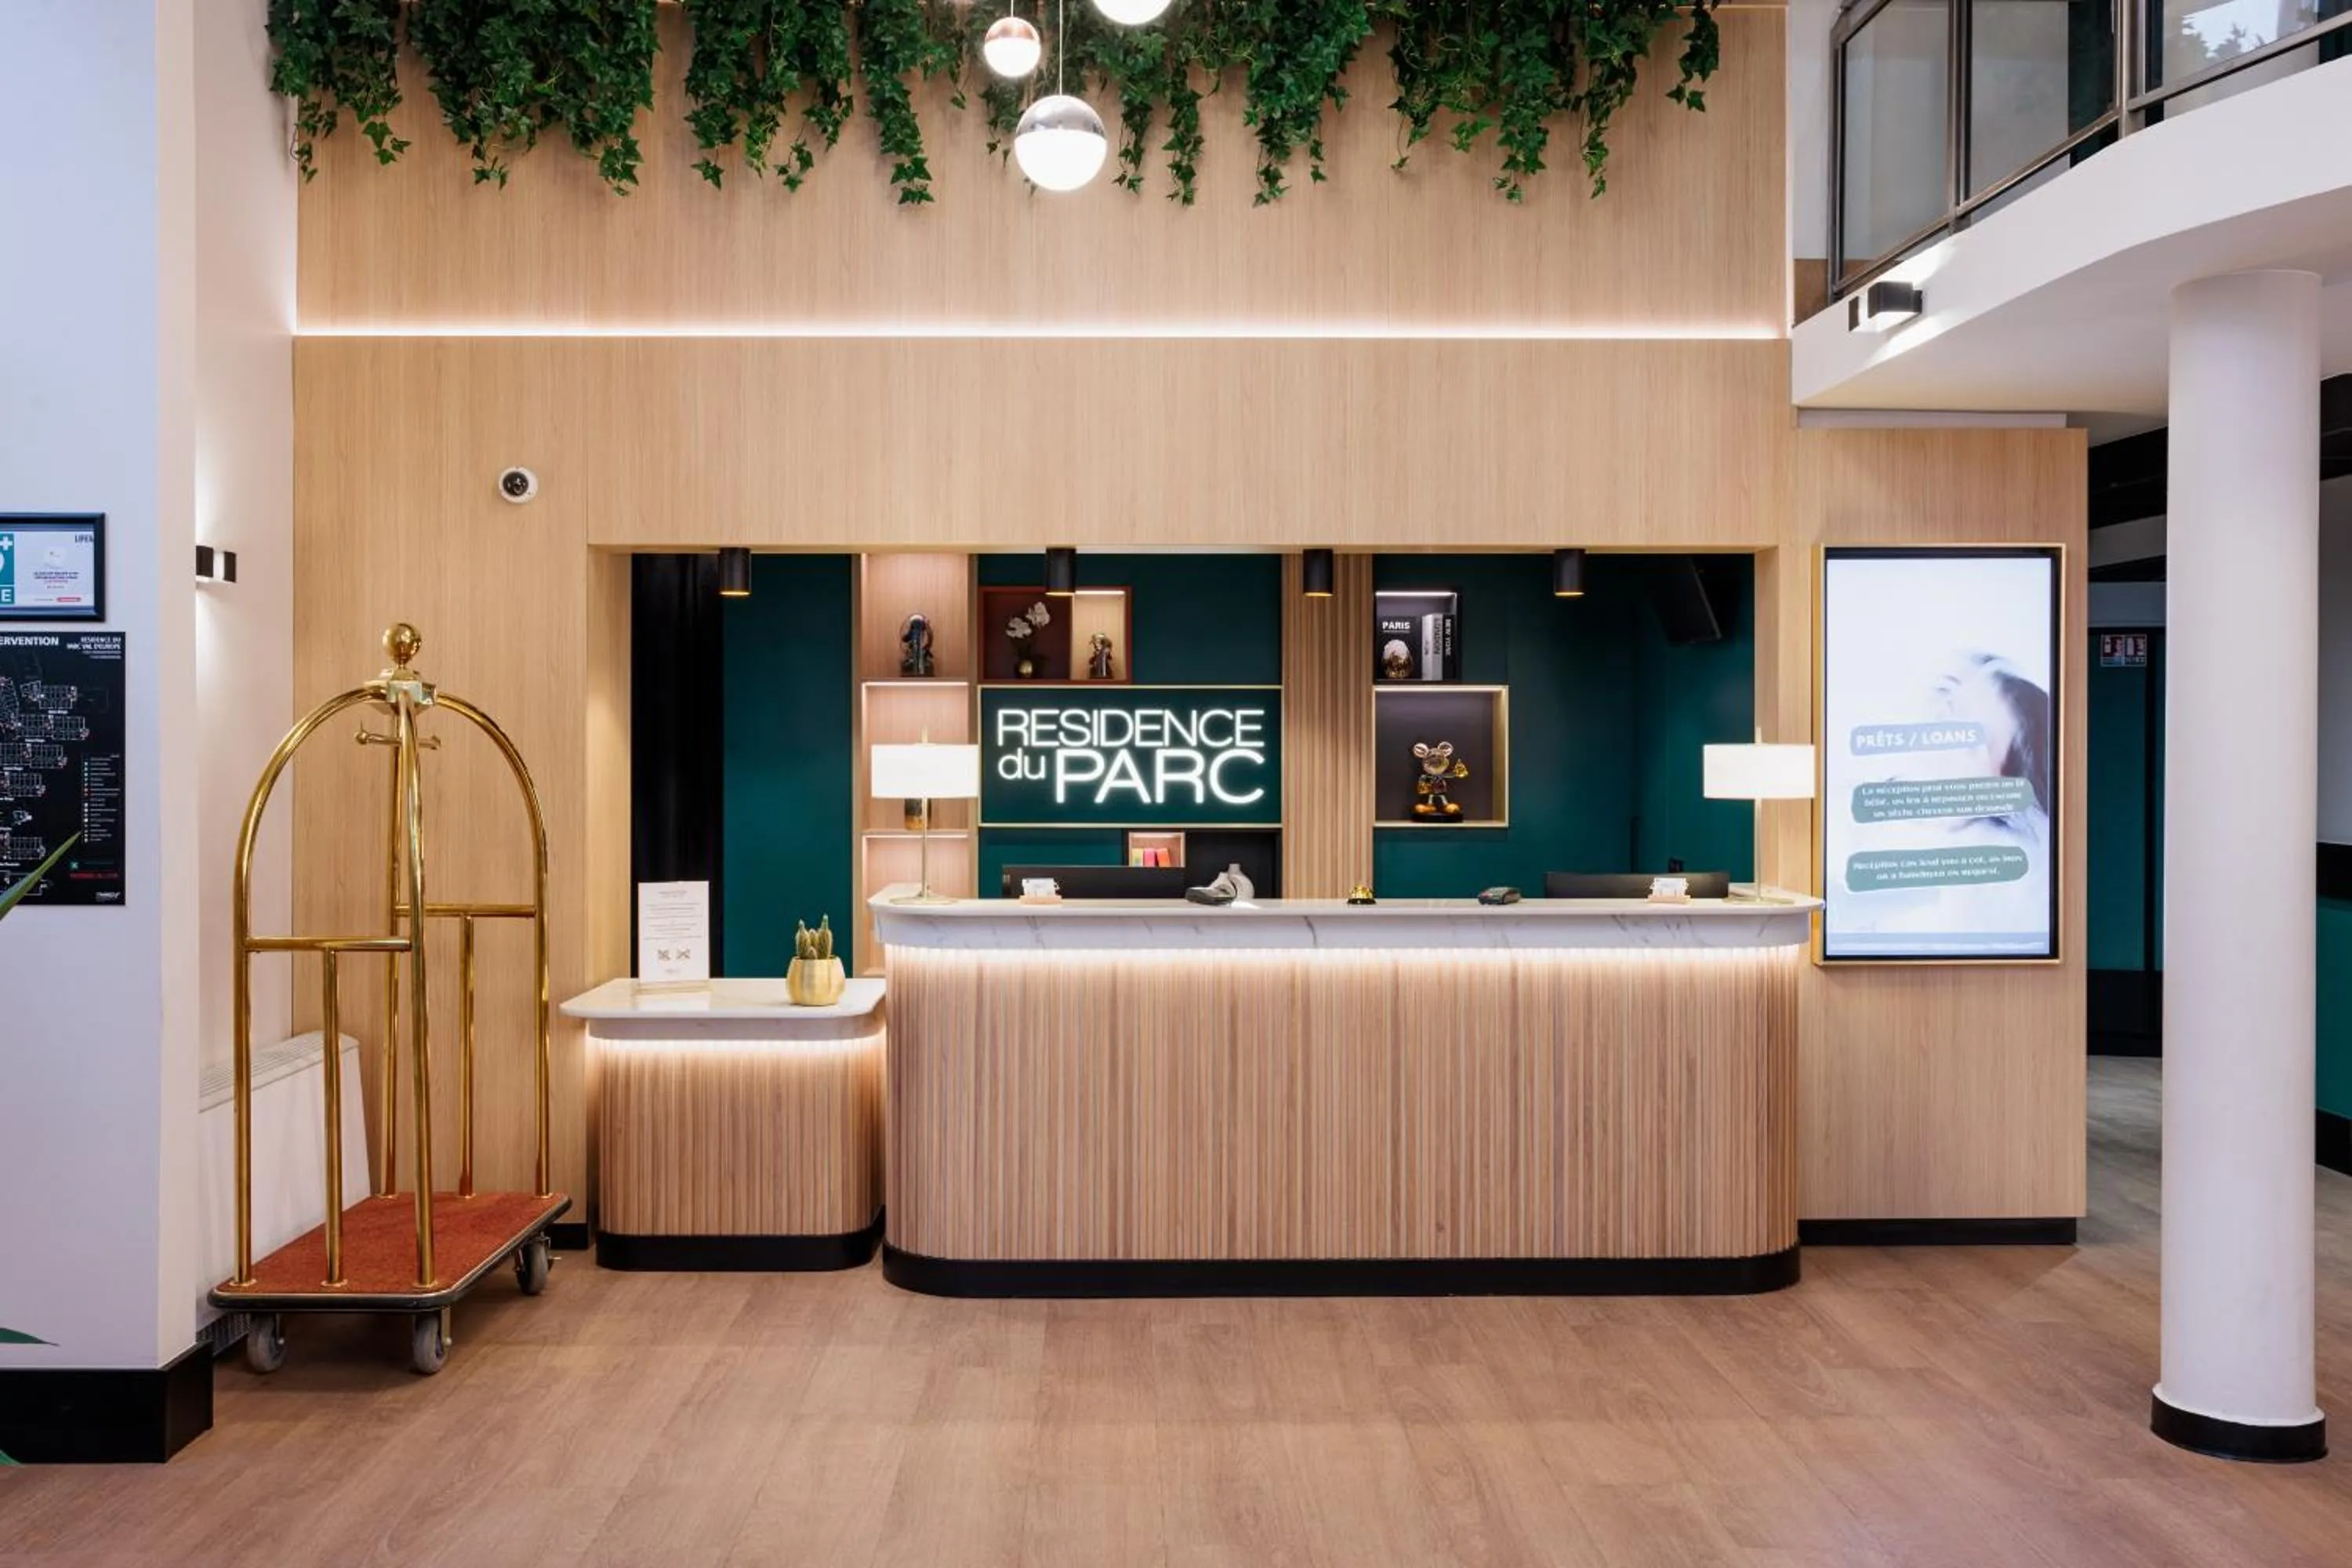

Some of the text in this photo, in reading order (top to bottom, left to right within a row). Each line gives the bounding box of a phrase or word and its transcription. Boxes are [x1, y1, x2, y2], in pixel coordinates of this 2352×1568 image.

[1382, 621, 1410, 630] PARIS
[996, 709, 1265, 748] RESIDENCE
[1856, 730, 1904, 749] PRÊTS
[1922, 728, 1977, 745] LOANS
[997, 748, 1265, 804] du PARC
